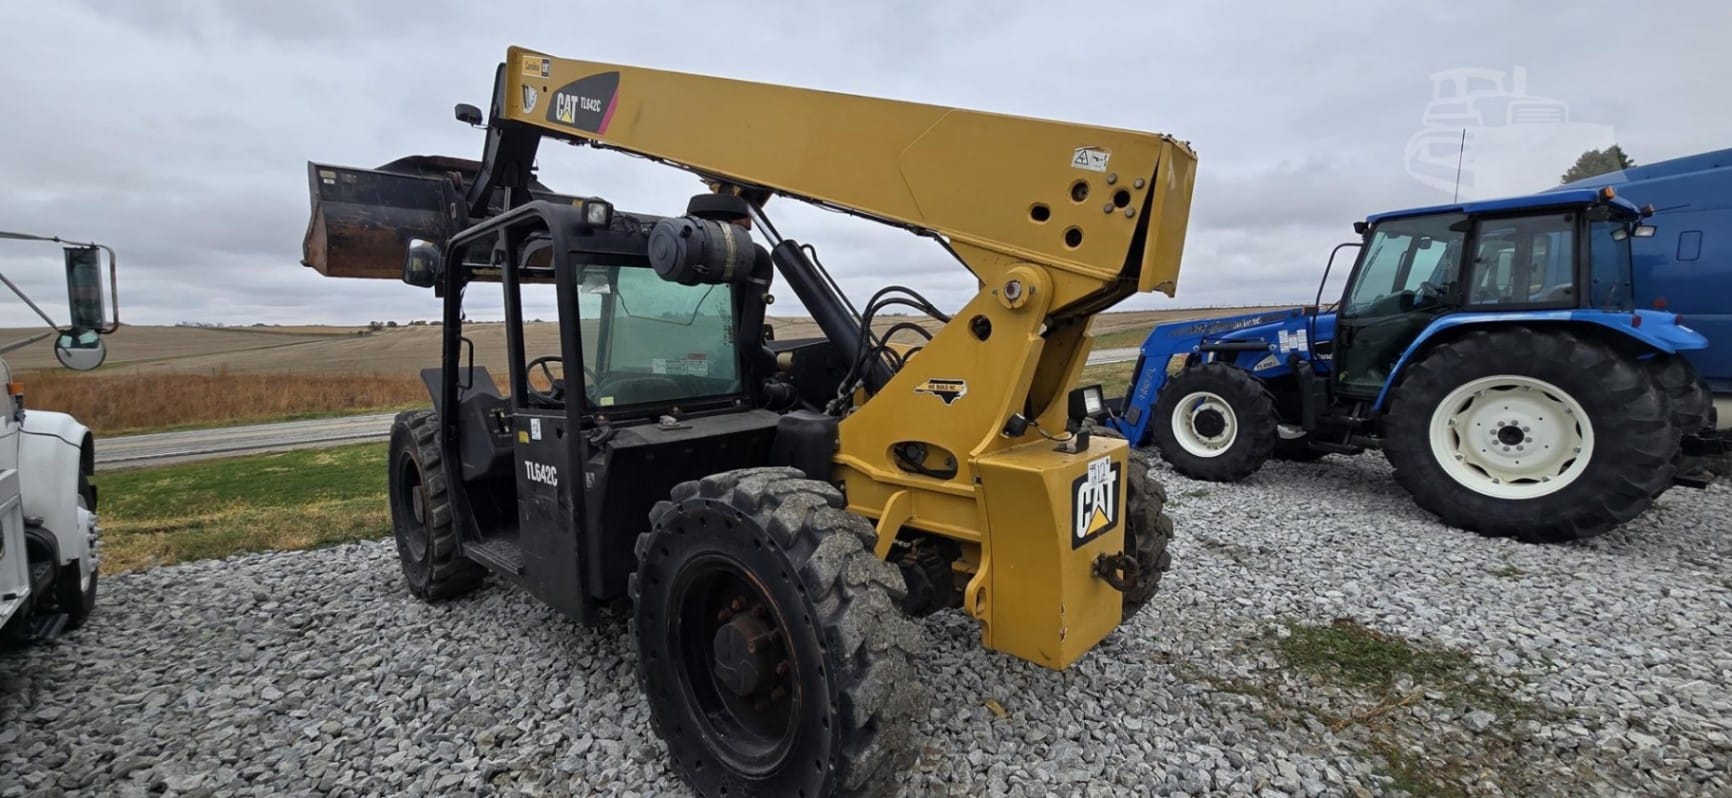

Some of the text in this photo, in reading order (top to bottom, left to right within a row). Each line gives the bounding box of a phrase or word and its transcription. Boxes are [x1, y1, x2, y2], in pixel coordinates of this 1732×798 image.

[556, 92, 601, 124] CAT TL642C
[524, 460, 558, 487] TL642C
[1076, 470, 1117, 539] CAT
